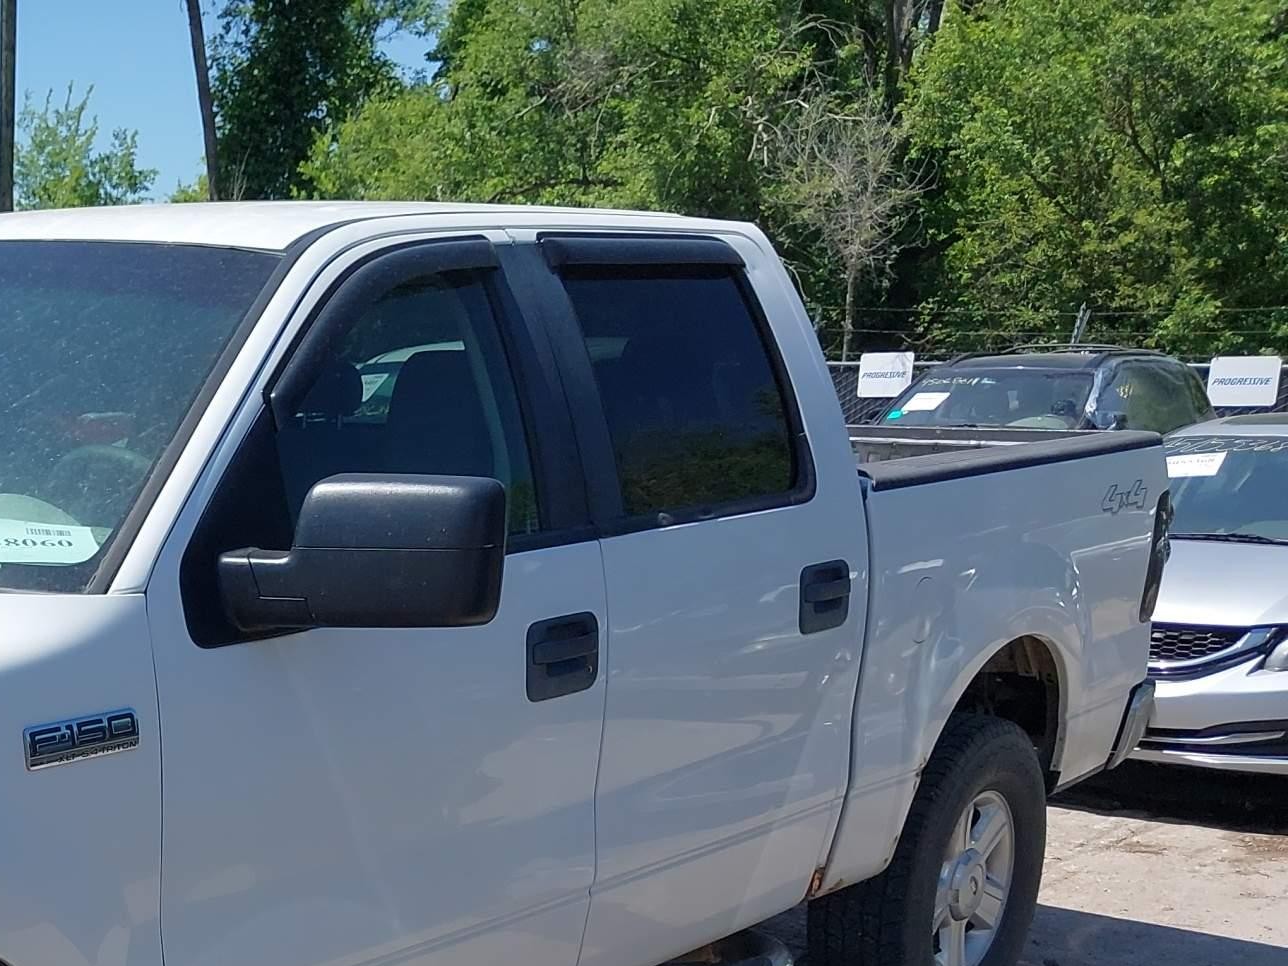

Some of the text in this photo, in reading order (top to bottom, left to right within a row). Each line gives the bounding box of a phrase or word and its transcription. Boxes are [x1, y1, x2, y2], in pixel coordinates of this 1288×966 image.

[861, 370, 907, 379] PROGRESSIVE
[1211, 377, 1273, 386] PROGRESSIVE
[1101, 479, 1149, 514] 4x4
[28, 712, 137, 758] F-150
